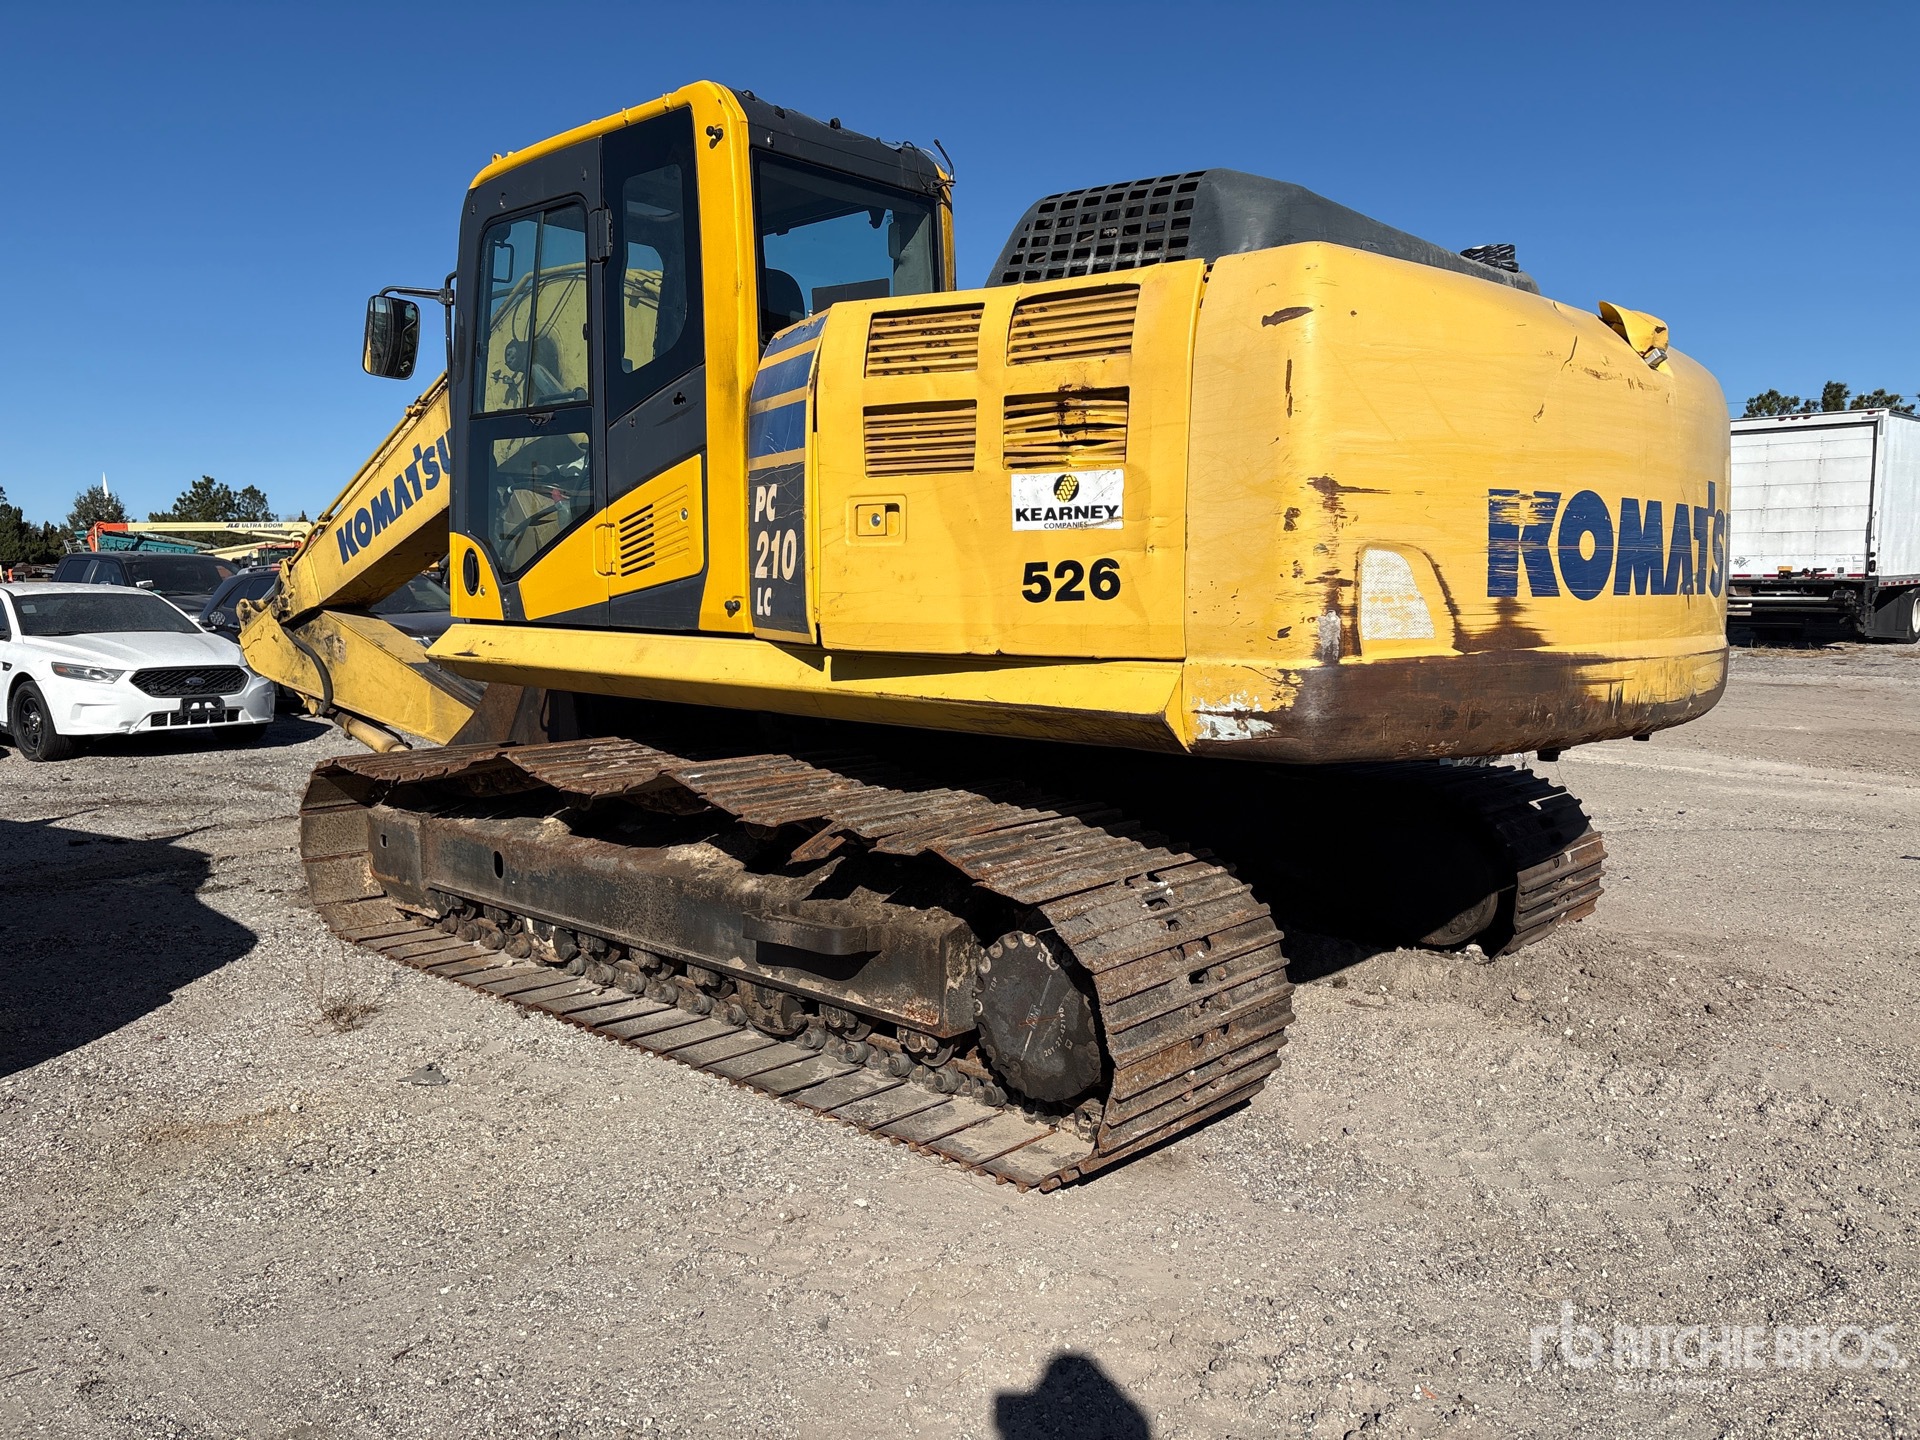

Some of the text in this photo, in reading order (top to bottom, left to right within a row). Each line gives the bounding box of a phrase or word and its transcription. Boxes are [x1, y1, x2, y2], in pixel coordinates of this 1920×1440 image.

[754, 483, 778, 522] PC
[1015, 505, 1119, 521] KEARNEY
[1044, 521, 1088, 529] COMPANIES
[1487, 480, 1730, 600] KOMATS
[754, 528, 797, 580] 210
[1021, 557, 1121, 603] 526
[756, 587, 772, 617] LC
[989, 976, 998, 992] TOP
